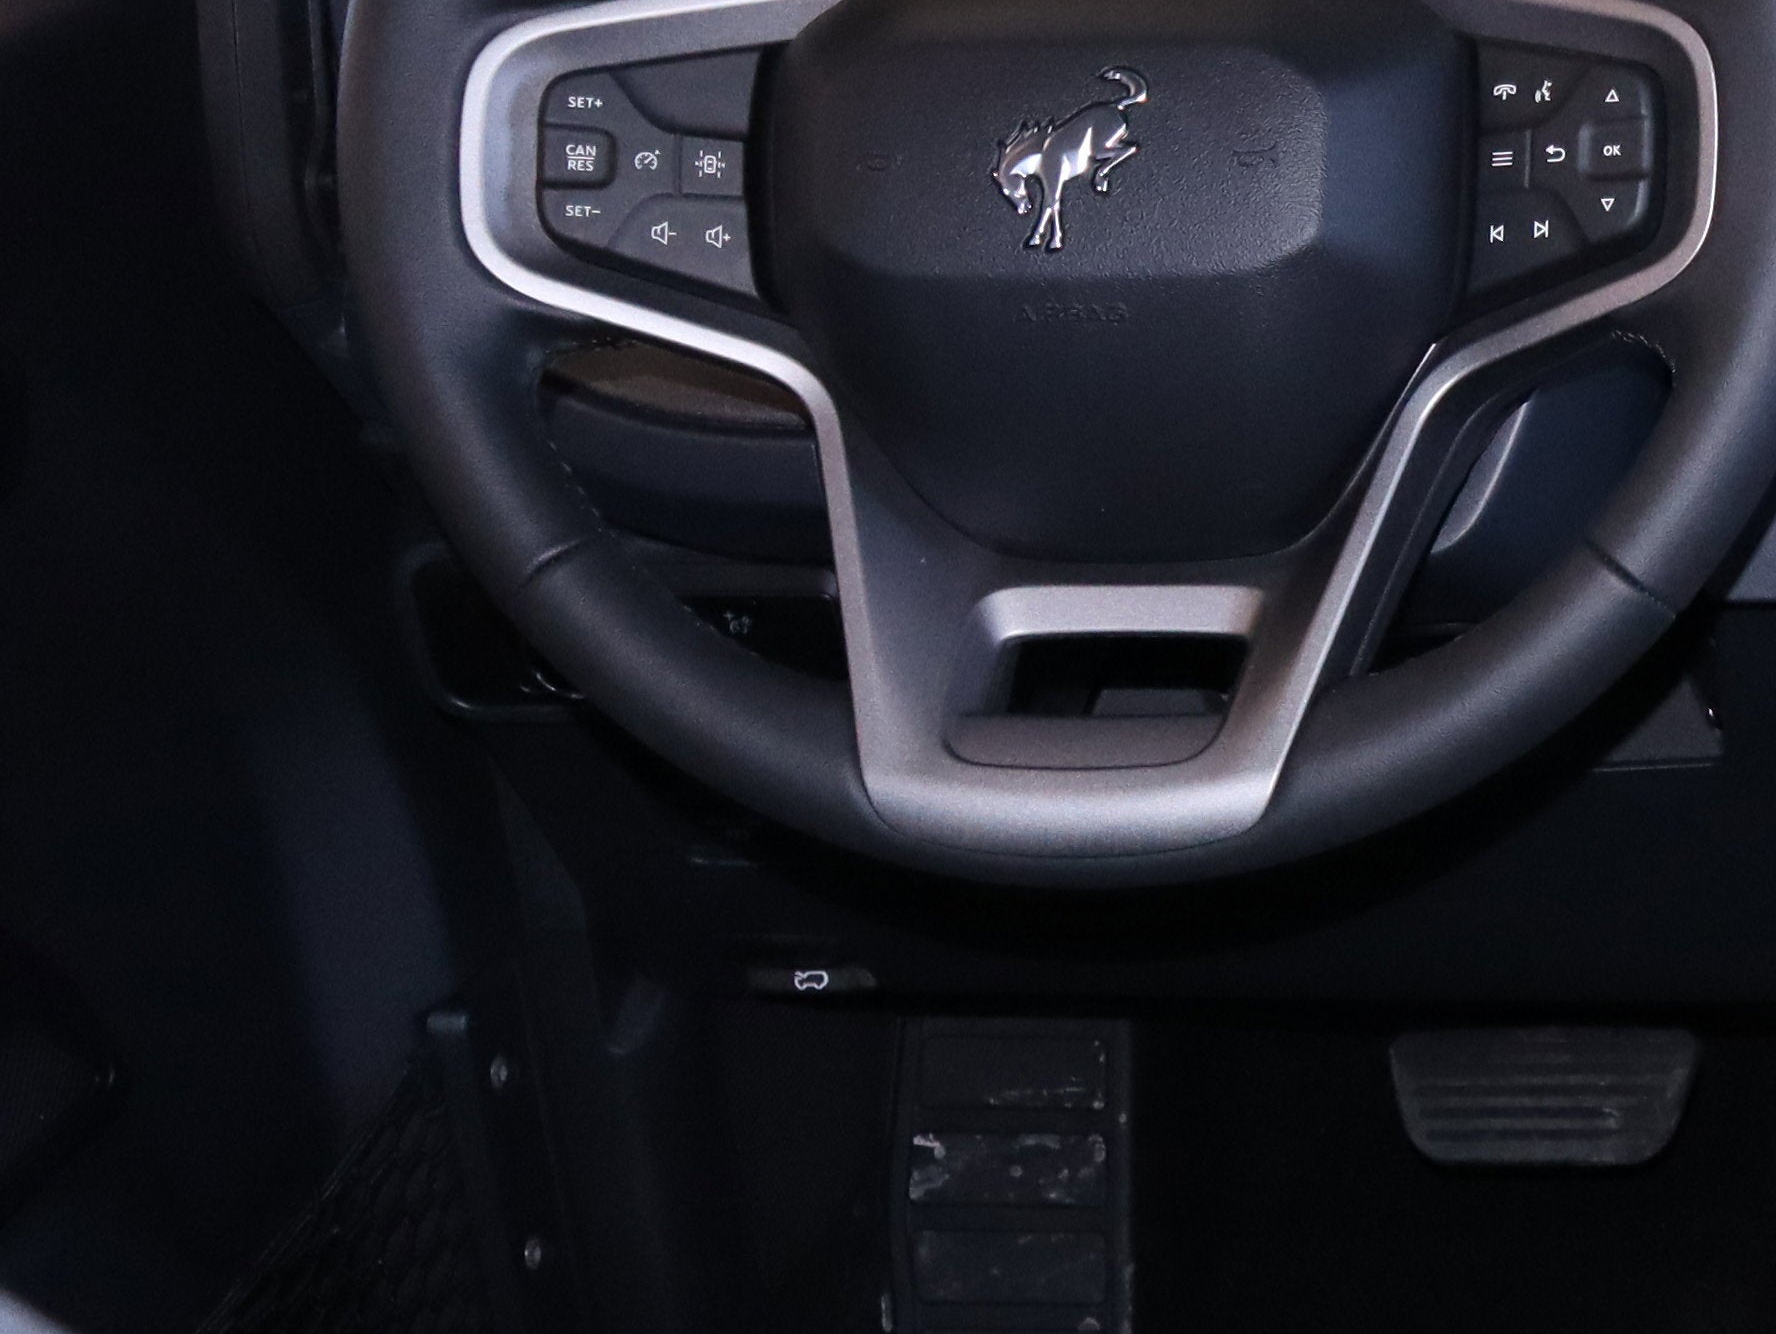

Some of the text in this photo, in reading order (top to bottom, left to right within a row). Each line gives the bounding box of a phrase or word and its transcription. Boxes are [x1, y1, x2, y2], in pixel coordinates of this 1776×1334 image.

[567, 97, 603, 109] SET+
[565, 144, 597, 156] CAN
[1603, 144, 1621, 156] OK
[567, 160, 594, 172] RES
